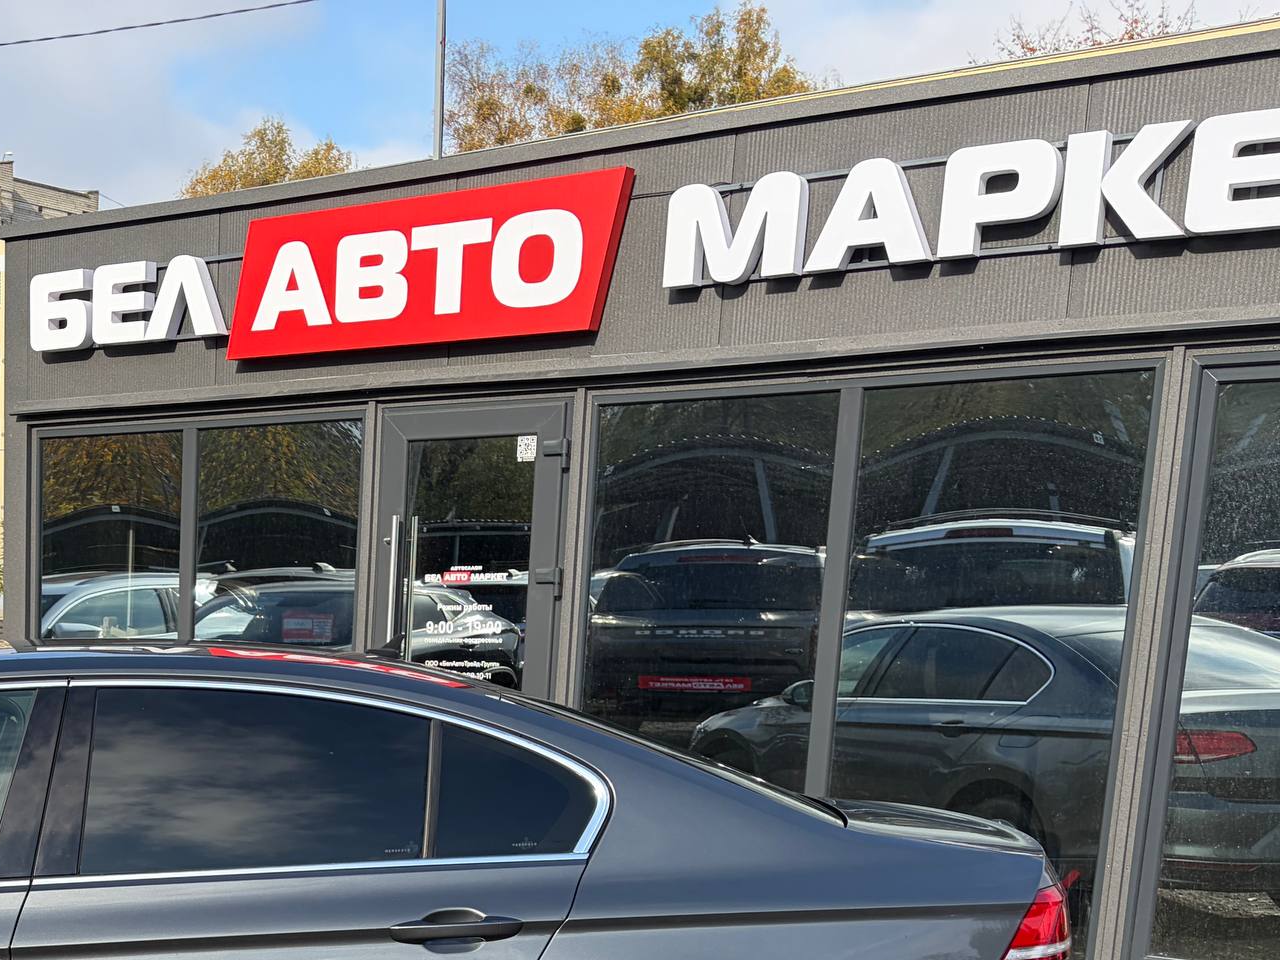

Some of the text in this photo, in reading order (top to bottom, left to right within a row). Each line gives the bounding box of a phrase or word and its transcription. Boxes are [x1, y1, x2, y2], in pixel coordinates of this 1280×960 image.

[29, 108, 1280, 352] БЕЛ АВТО МАРКЕ
[424, 572, 509, 582] БЕЛ АВТО МАРКЕТ
[463, 602, 493, 612] работы
[425, 621, 454, 634] 9:00
[467, 620, 502, 634] 19:00
[425, 660, 439, 668] ООО
